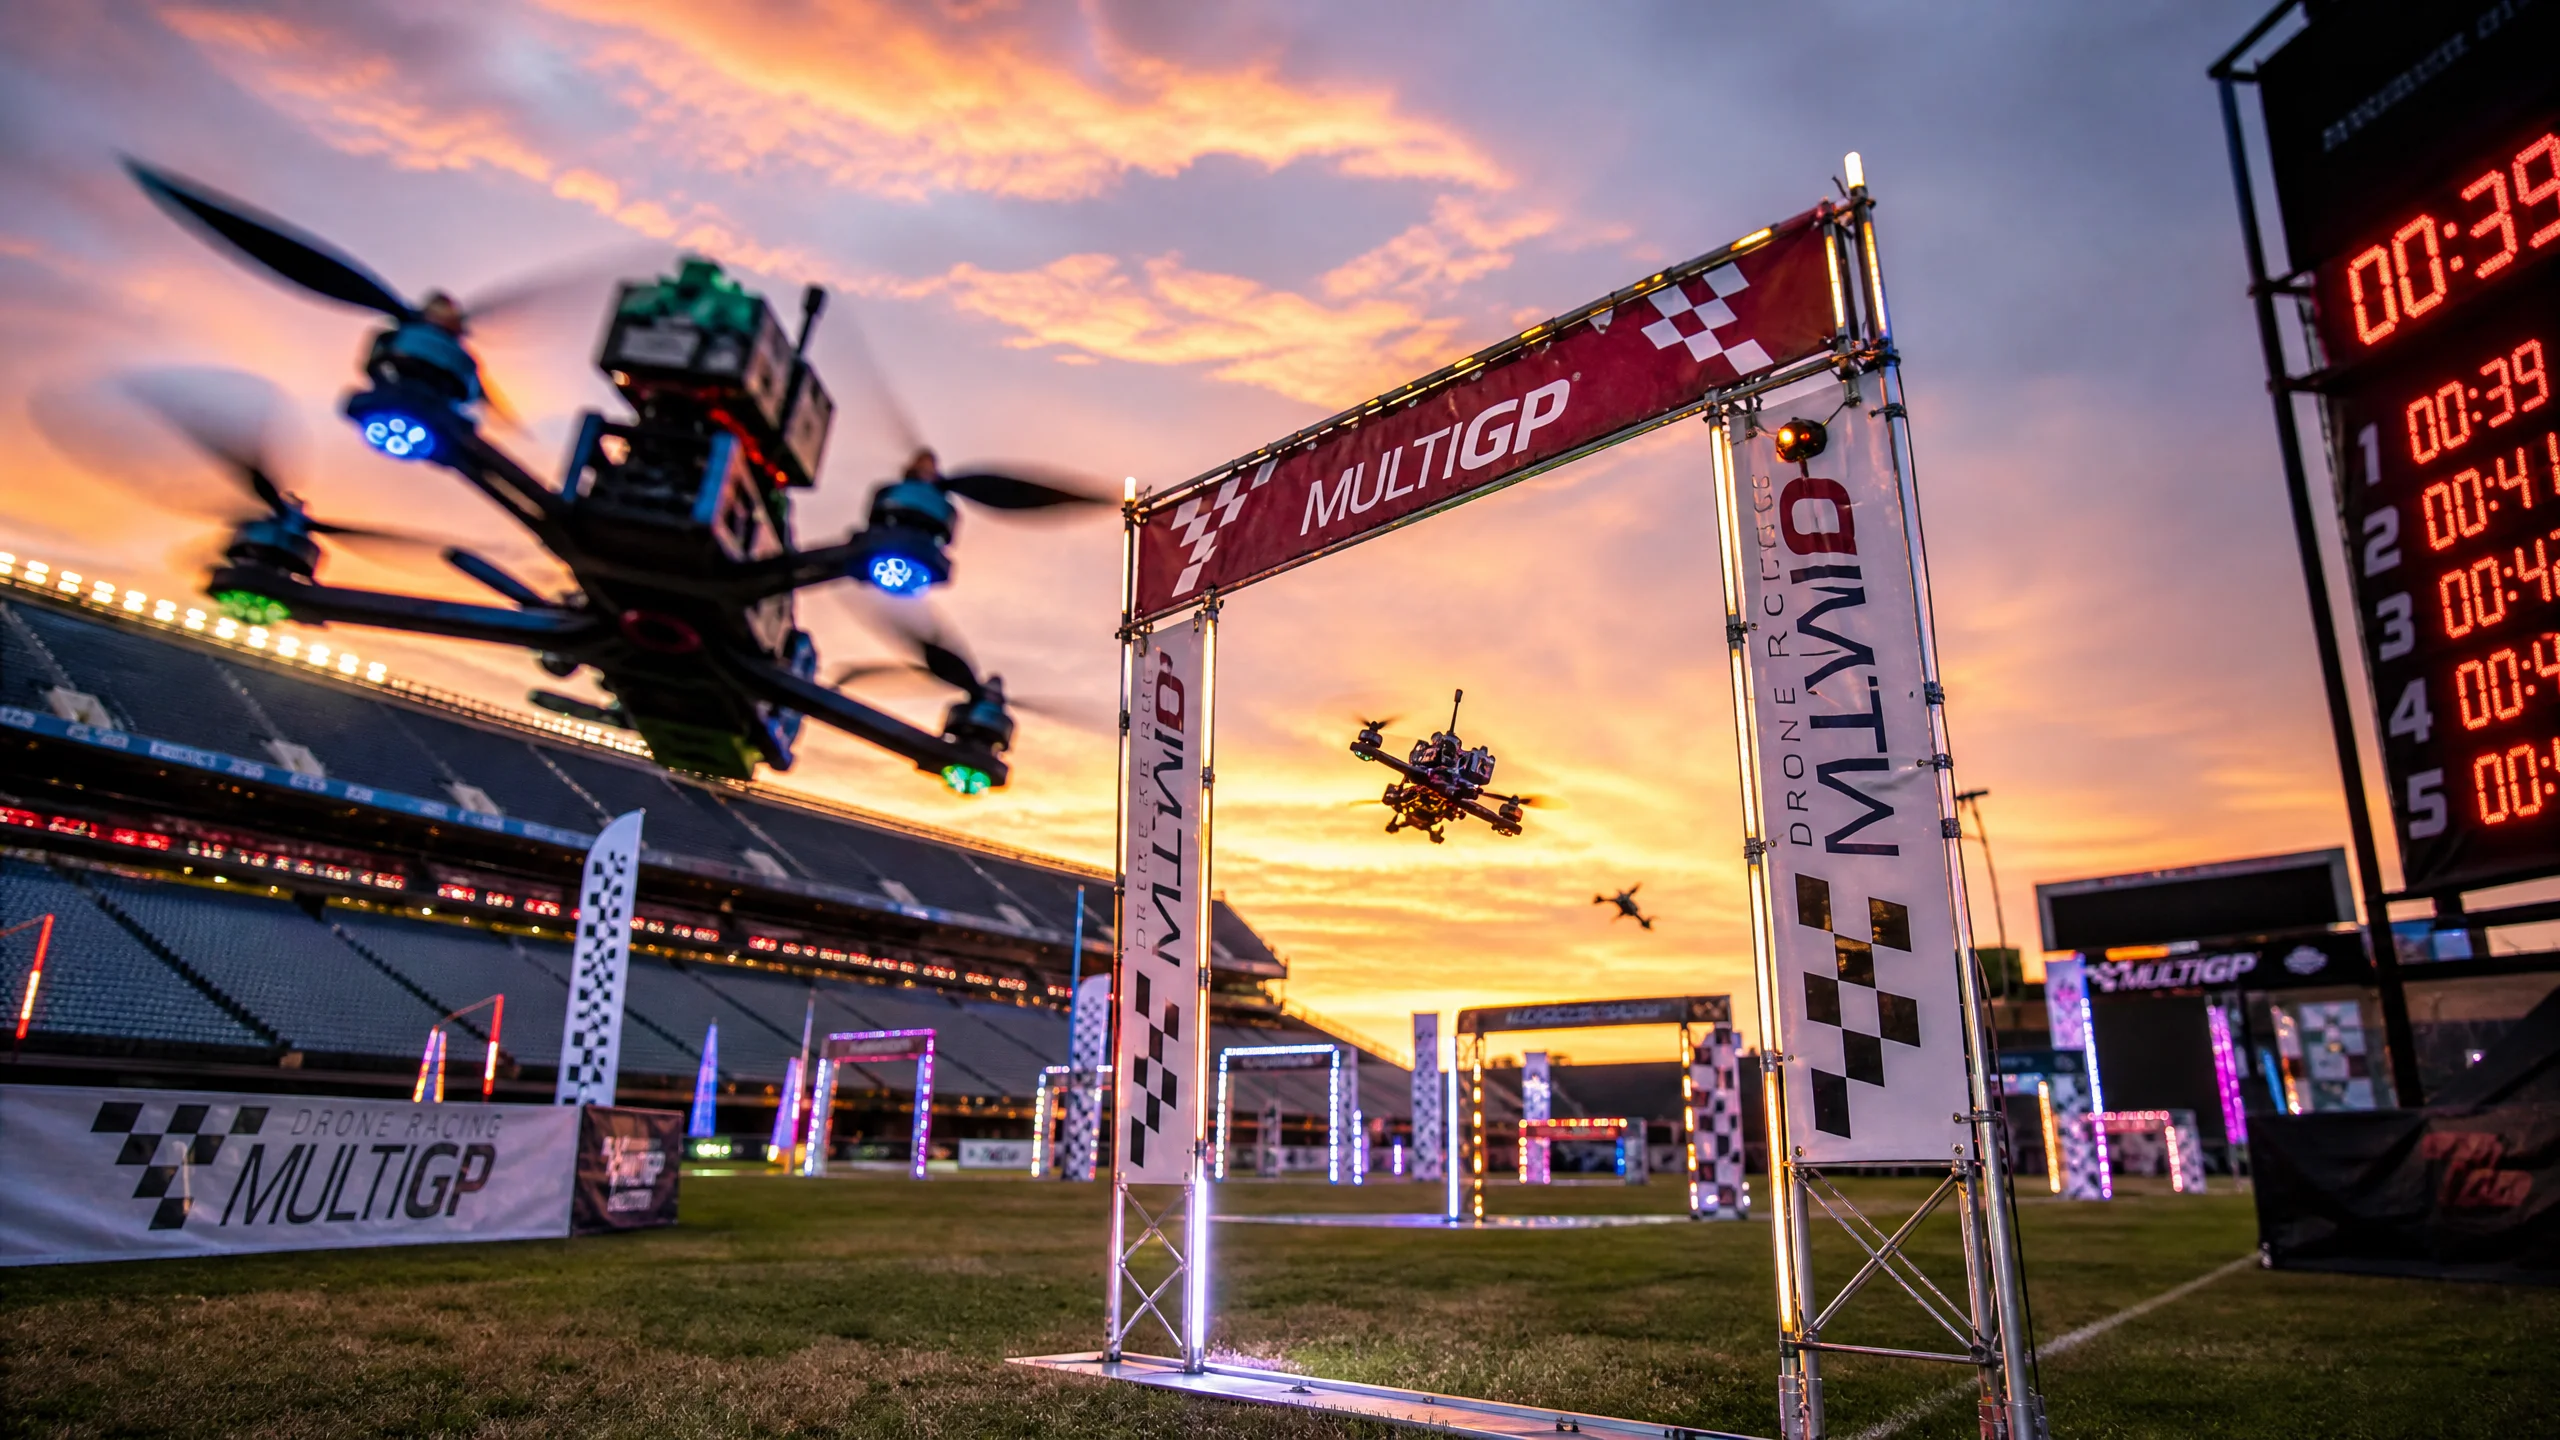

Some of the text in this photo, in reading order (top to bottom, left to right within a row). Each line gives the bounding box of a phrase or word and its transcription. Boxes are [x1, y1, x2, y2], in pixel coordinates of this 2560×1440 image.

[2347, 133, 2560, 345] 00:39
[2357, 339, 2549, 485] 1 00:39
[1300, 379, 1570, 536] MULTIGP
[2362, 505, 2400, 577] 2
[2376, 591, 2414, 661] 3
[2389, 678, 2433, 743] 4
[1774, 686, 1813, 848] DRONE
[2406, 736, 2560, 840] 5 00:
[2117, 952, 2257, 990] MULTIGP
[290, 1108, 504, 1139] DRONE RACING
[218, 1142, 497, 1227] MULTIGP
